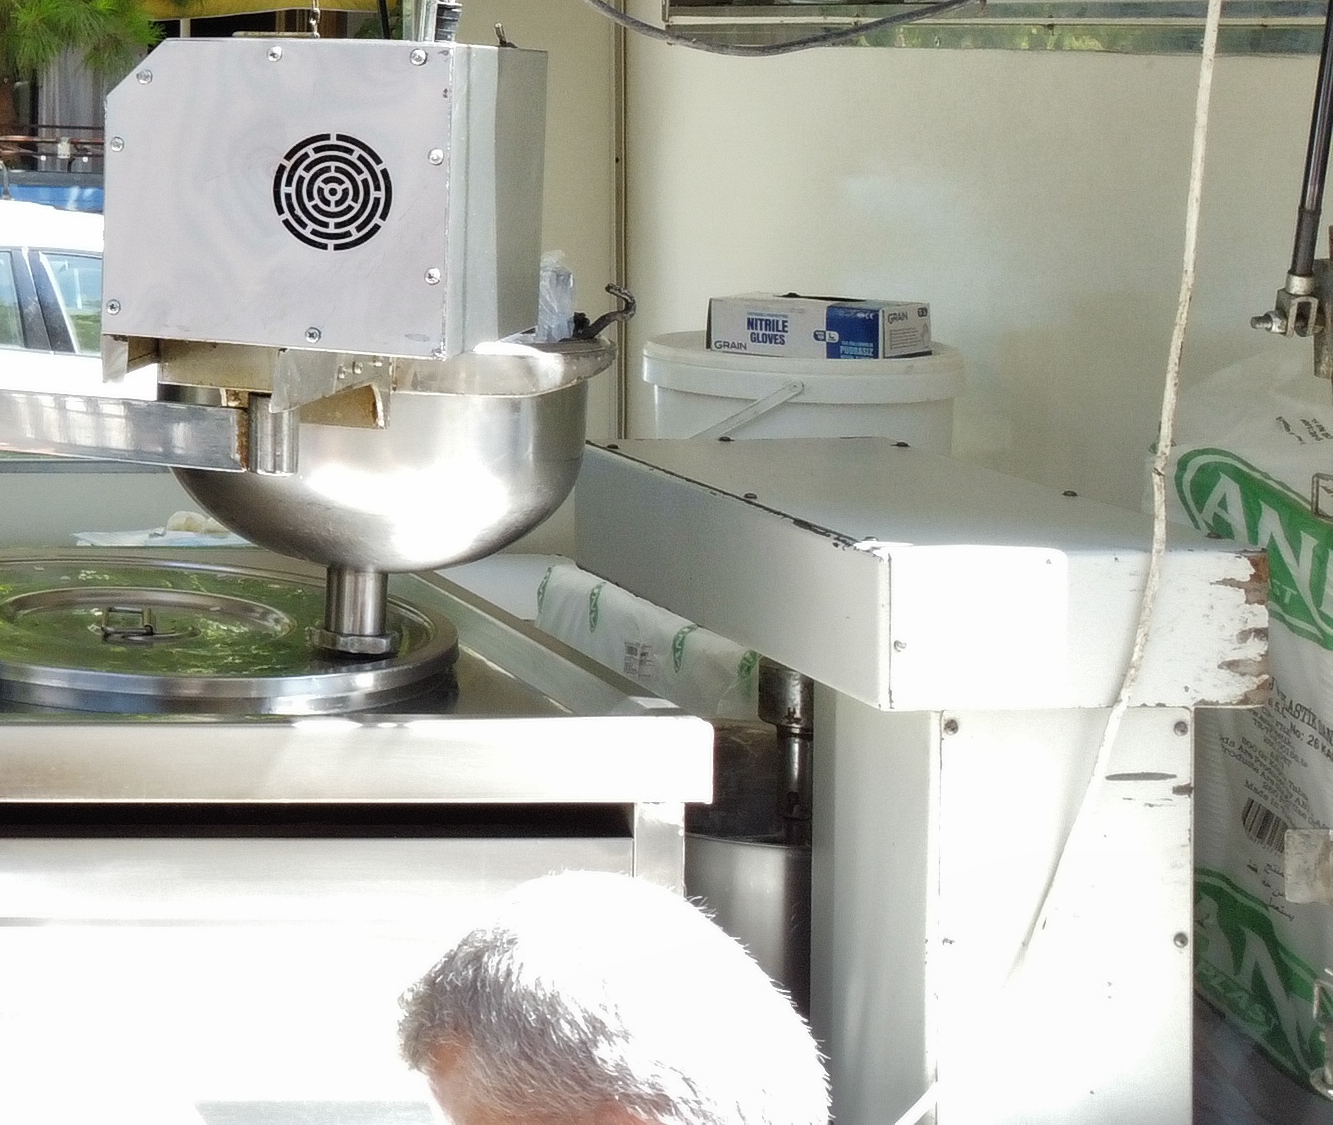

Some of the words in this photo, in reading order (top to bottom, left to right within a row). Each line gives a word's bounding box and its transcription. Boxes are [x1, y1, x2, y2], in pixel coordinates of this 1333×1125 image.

[747, 317, 788, 333] NITRILE
[714, 340, 747, 350] GRAIN
[750, 332, 786, 345] GLOVES
[1283, 700, 1318, 731] ASTİK
